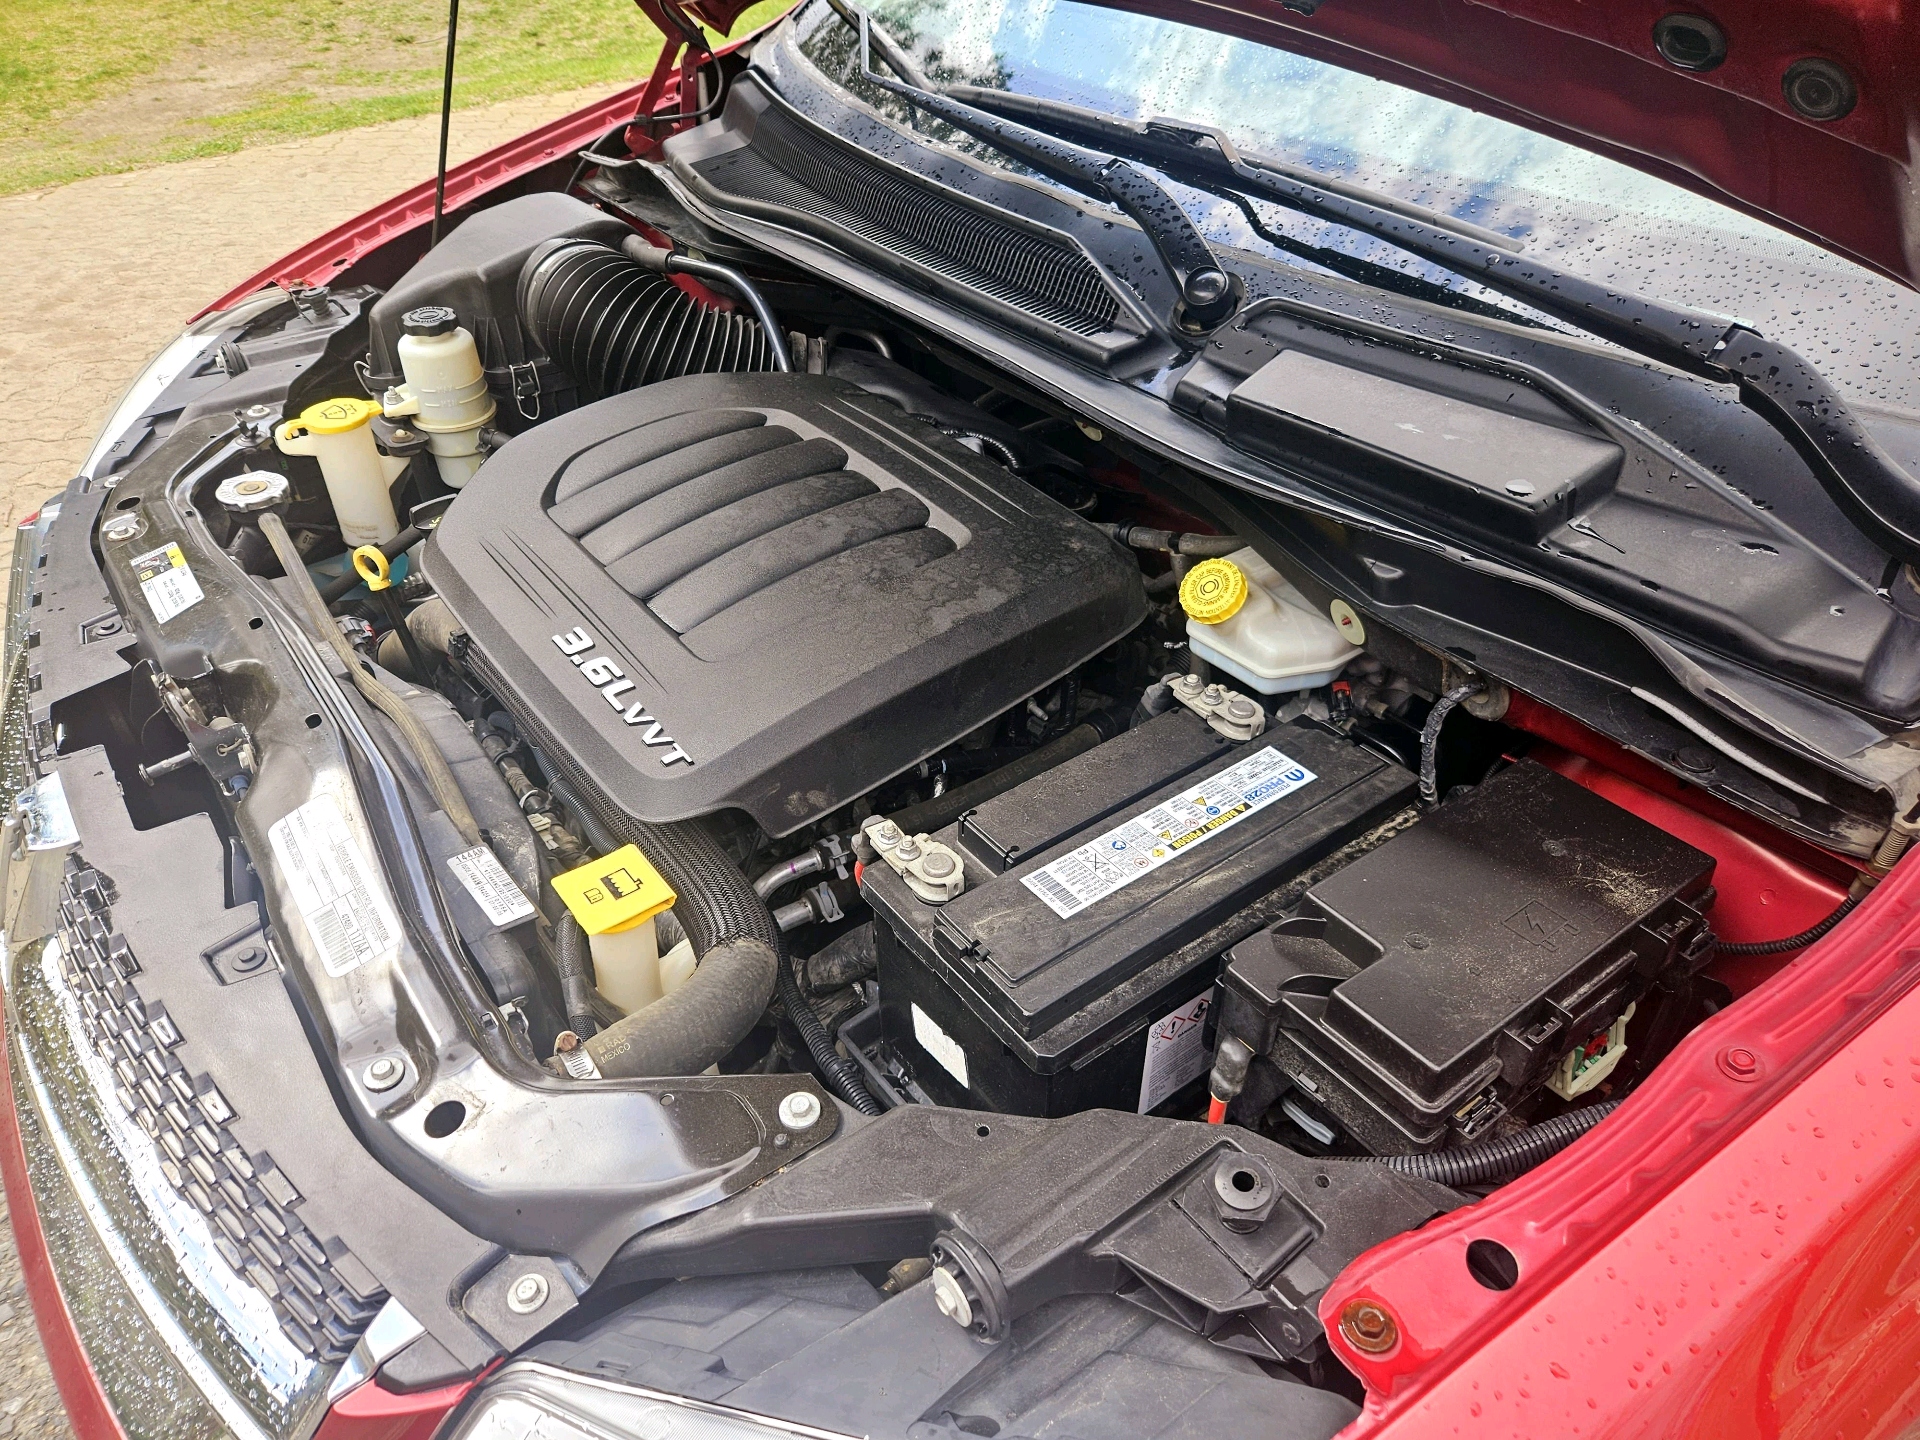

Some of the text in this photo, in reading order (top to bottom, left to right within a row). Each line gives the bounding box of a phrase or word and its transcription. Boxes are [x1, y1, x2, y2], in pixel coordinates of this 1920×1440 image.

[1245, 777, 1286, 802] PRO28
[1206, 809, 1239, 829] DANGER
[1172, 830, 1203, 849] POISON
[600, 1042, 631, 1064] MEXICO
